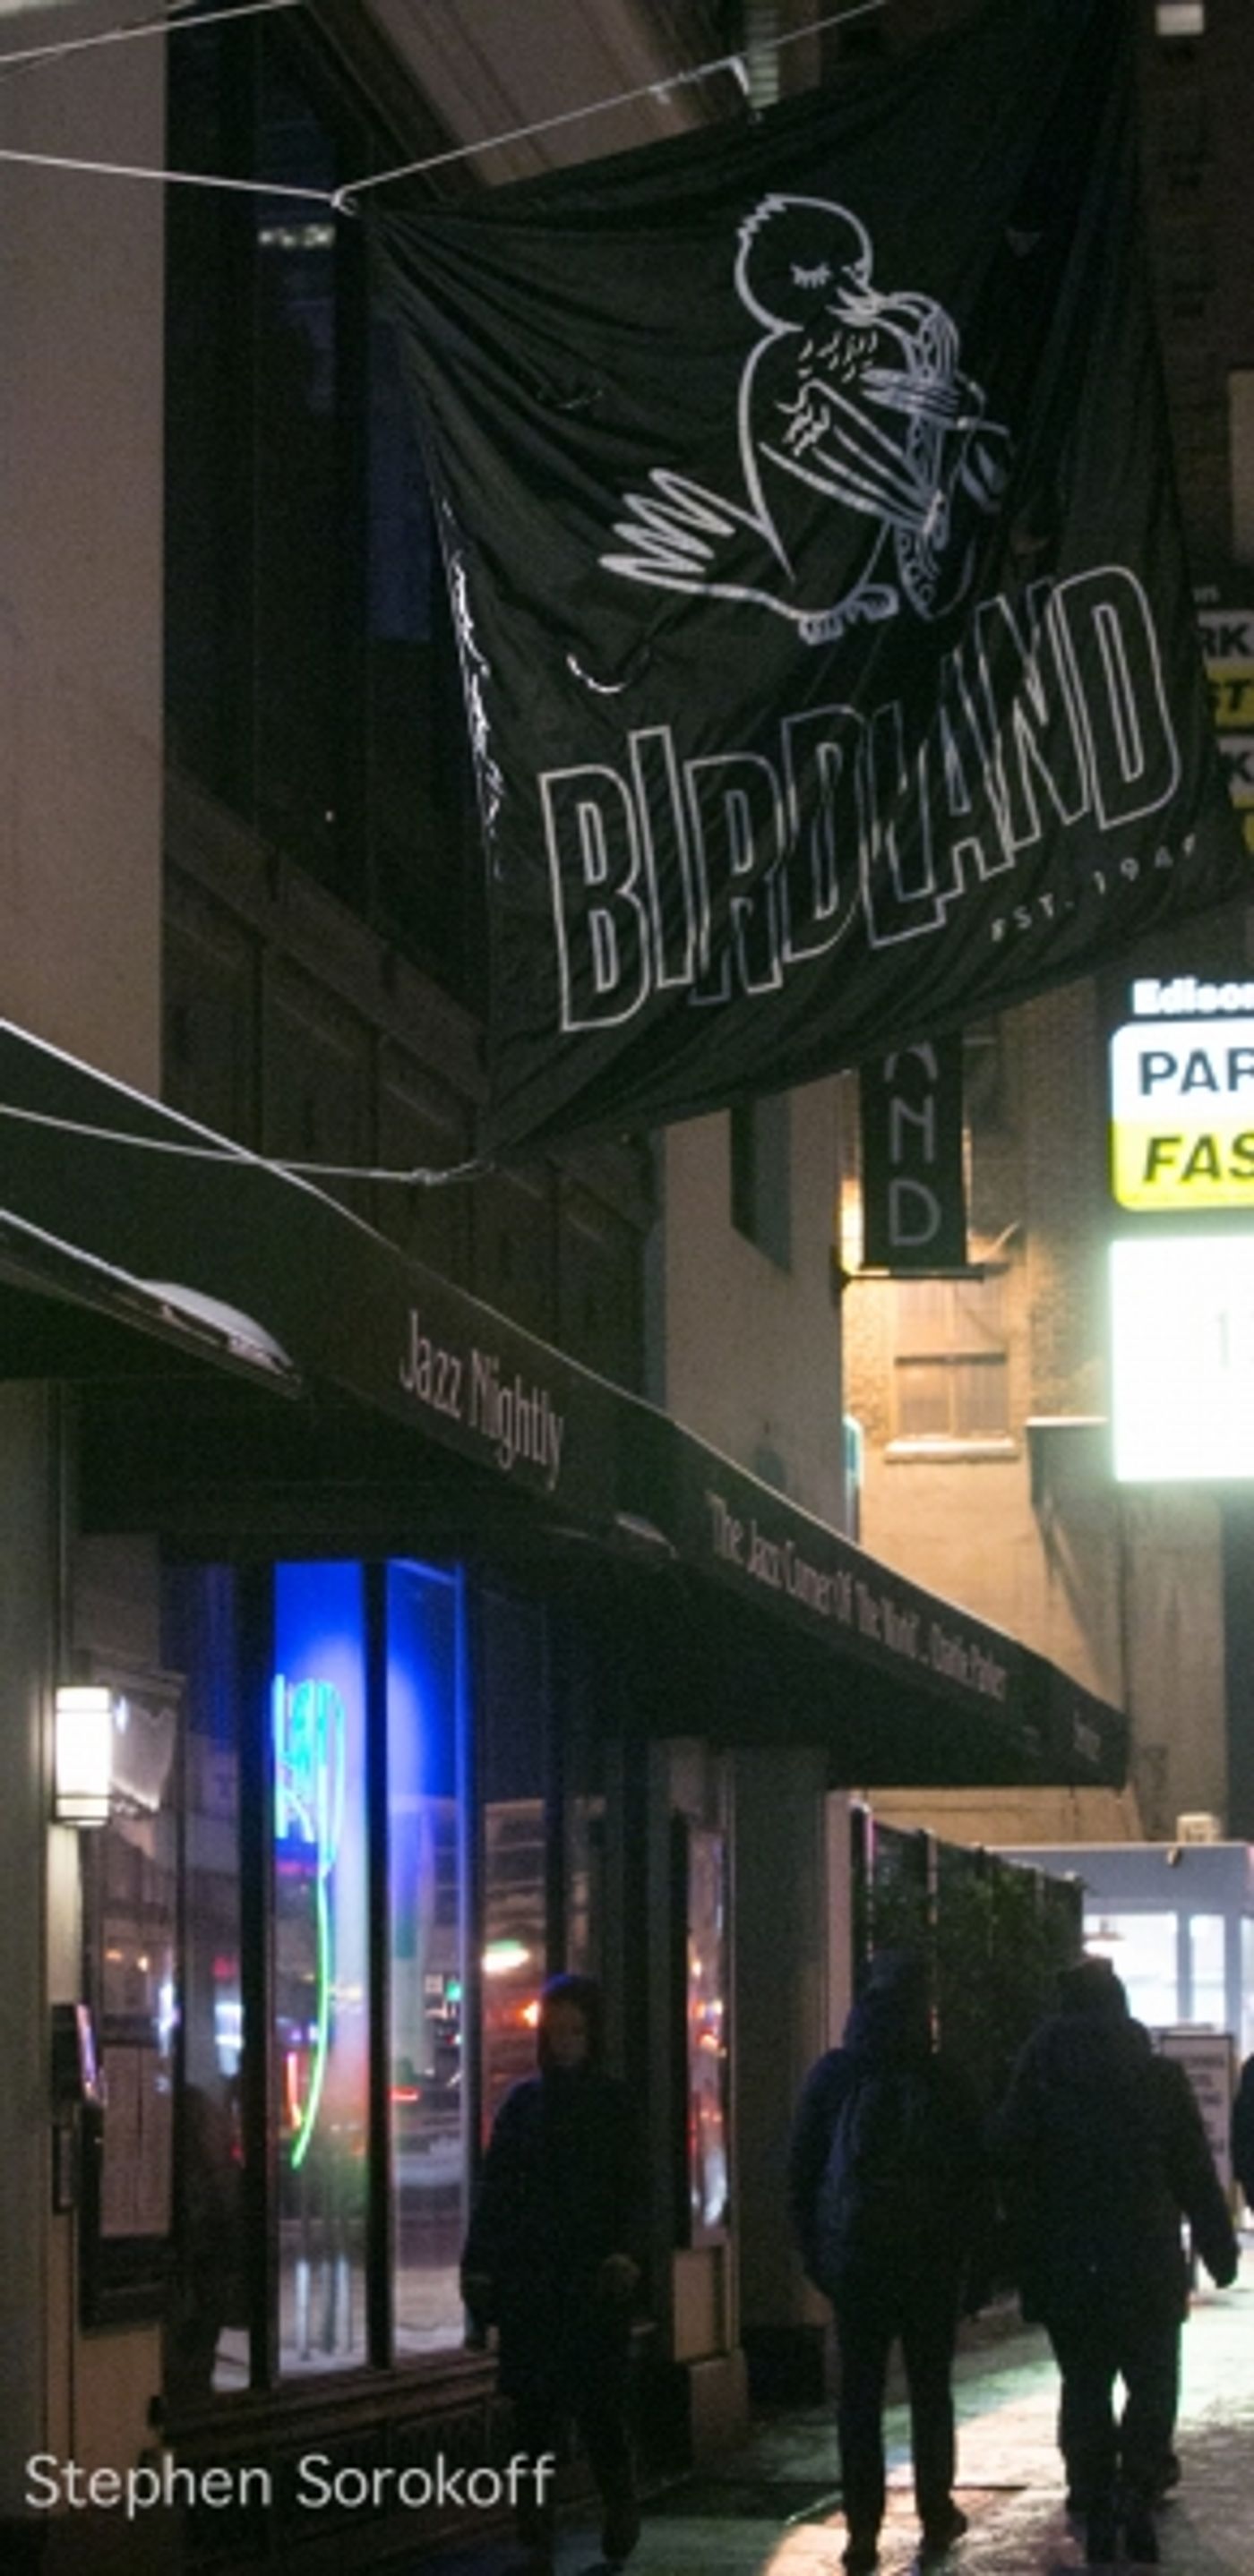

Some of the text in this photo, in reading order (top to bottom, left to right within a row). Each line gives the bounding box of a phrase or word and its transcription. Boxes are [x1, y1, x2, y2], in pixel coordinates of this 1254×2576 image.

[538, 567, 1182, 1032] BIRDLAND
[399, 1309, 564, 1492] Jazz Nightly
